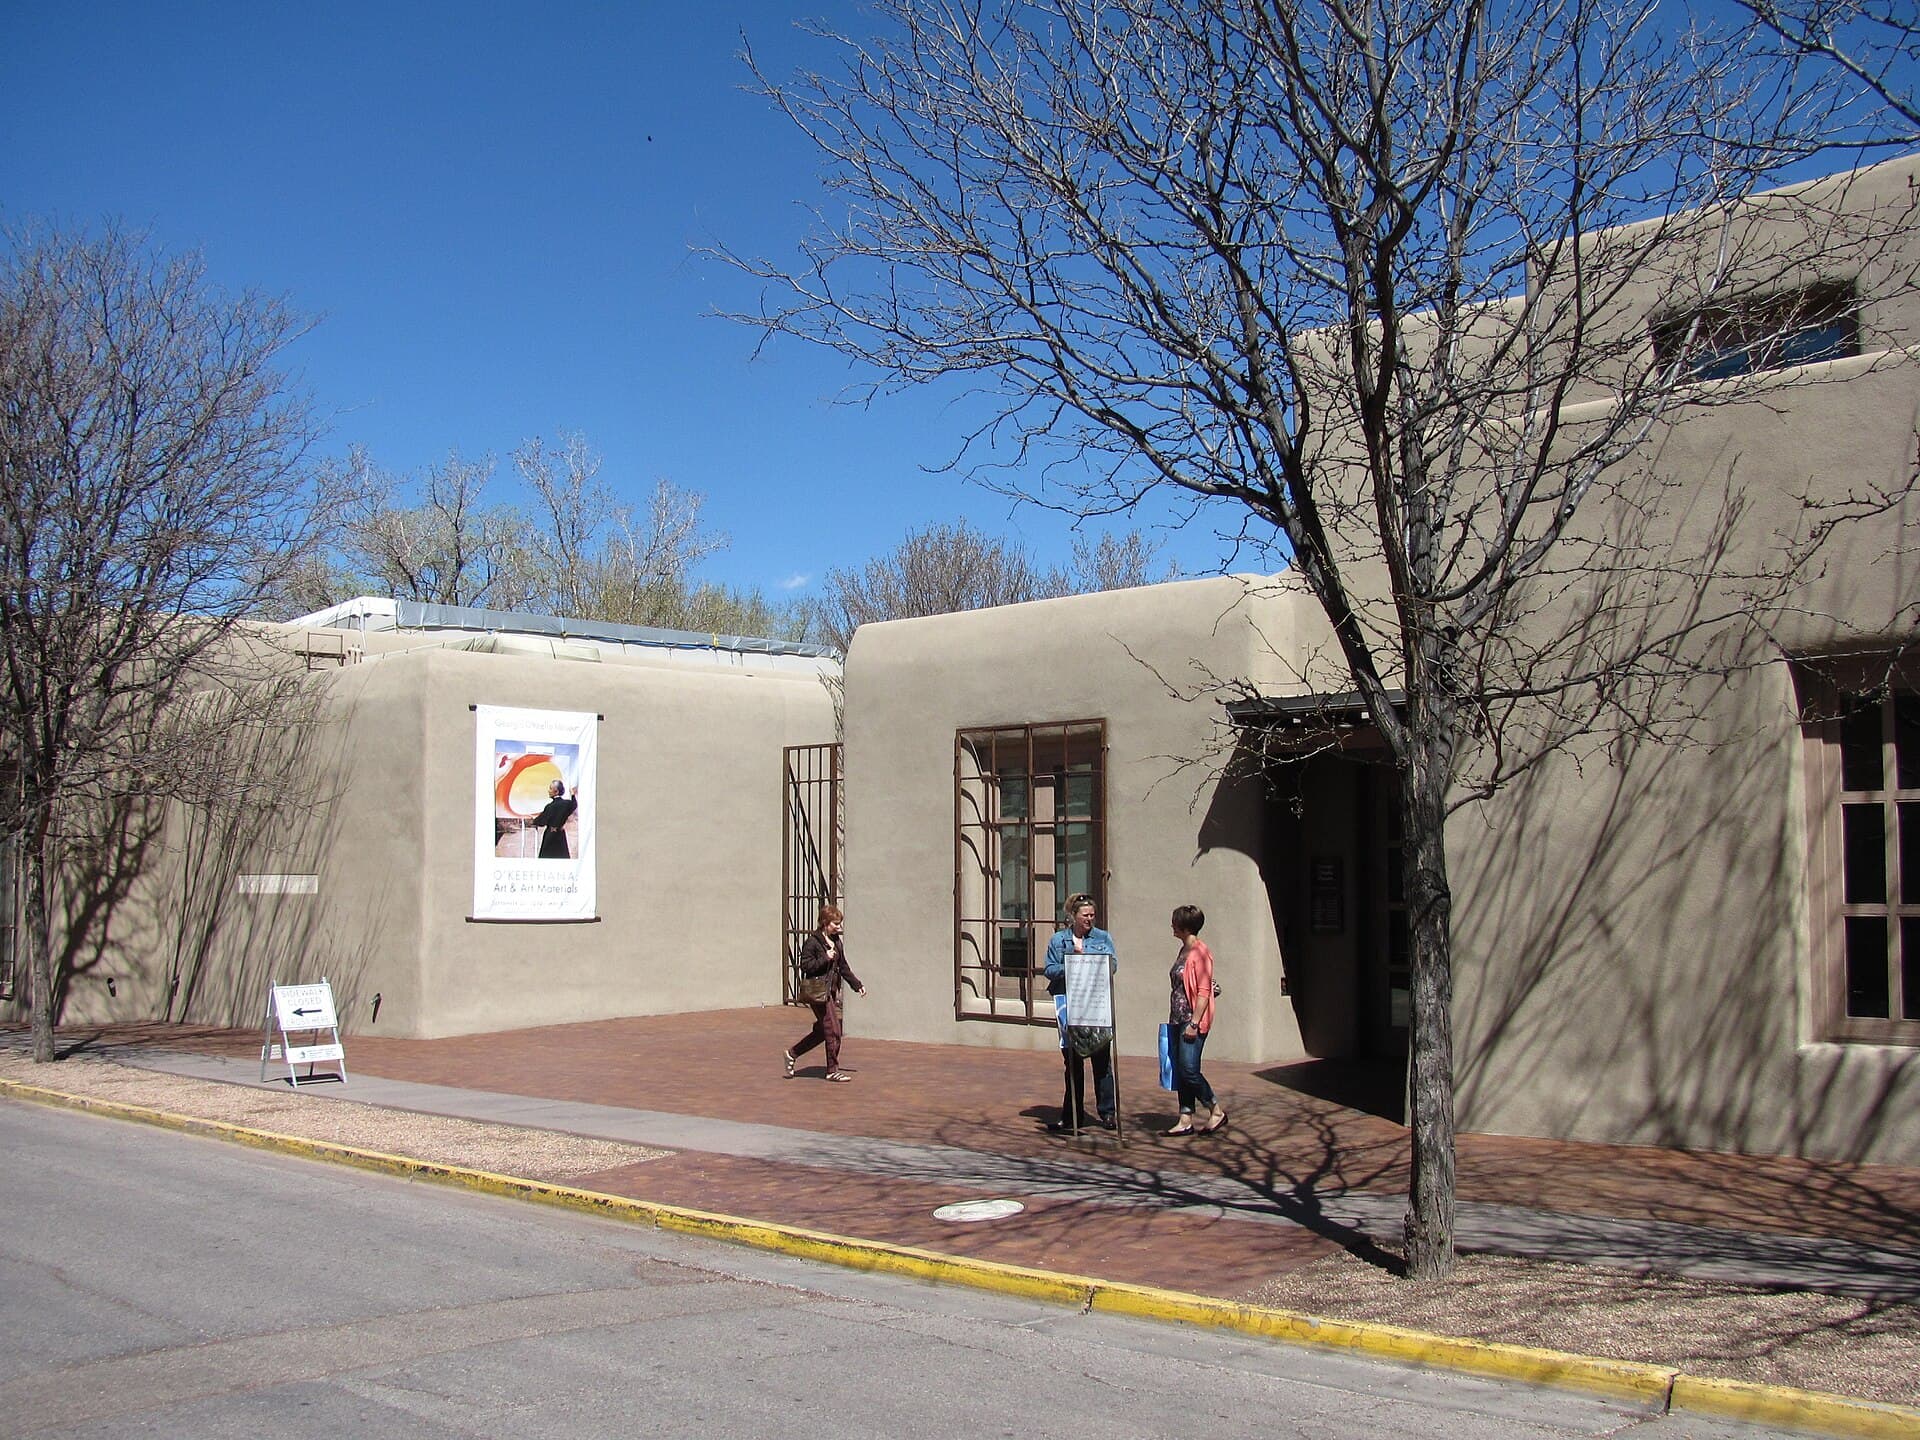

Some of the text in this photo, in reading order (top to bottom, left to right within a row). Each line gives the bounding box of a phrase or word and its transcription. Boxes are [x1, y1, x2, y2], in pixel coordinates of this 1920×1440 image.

[493, 882, 578, 894] Art & Art Materials
[281, 988, 324, 998] SIDEWALK
[287, 997, 322, 1006] CLOSED
